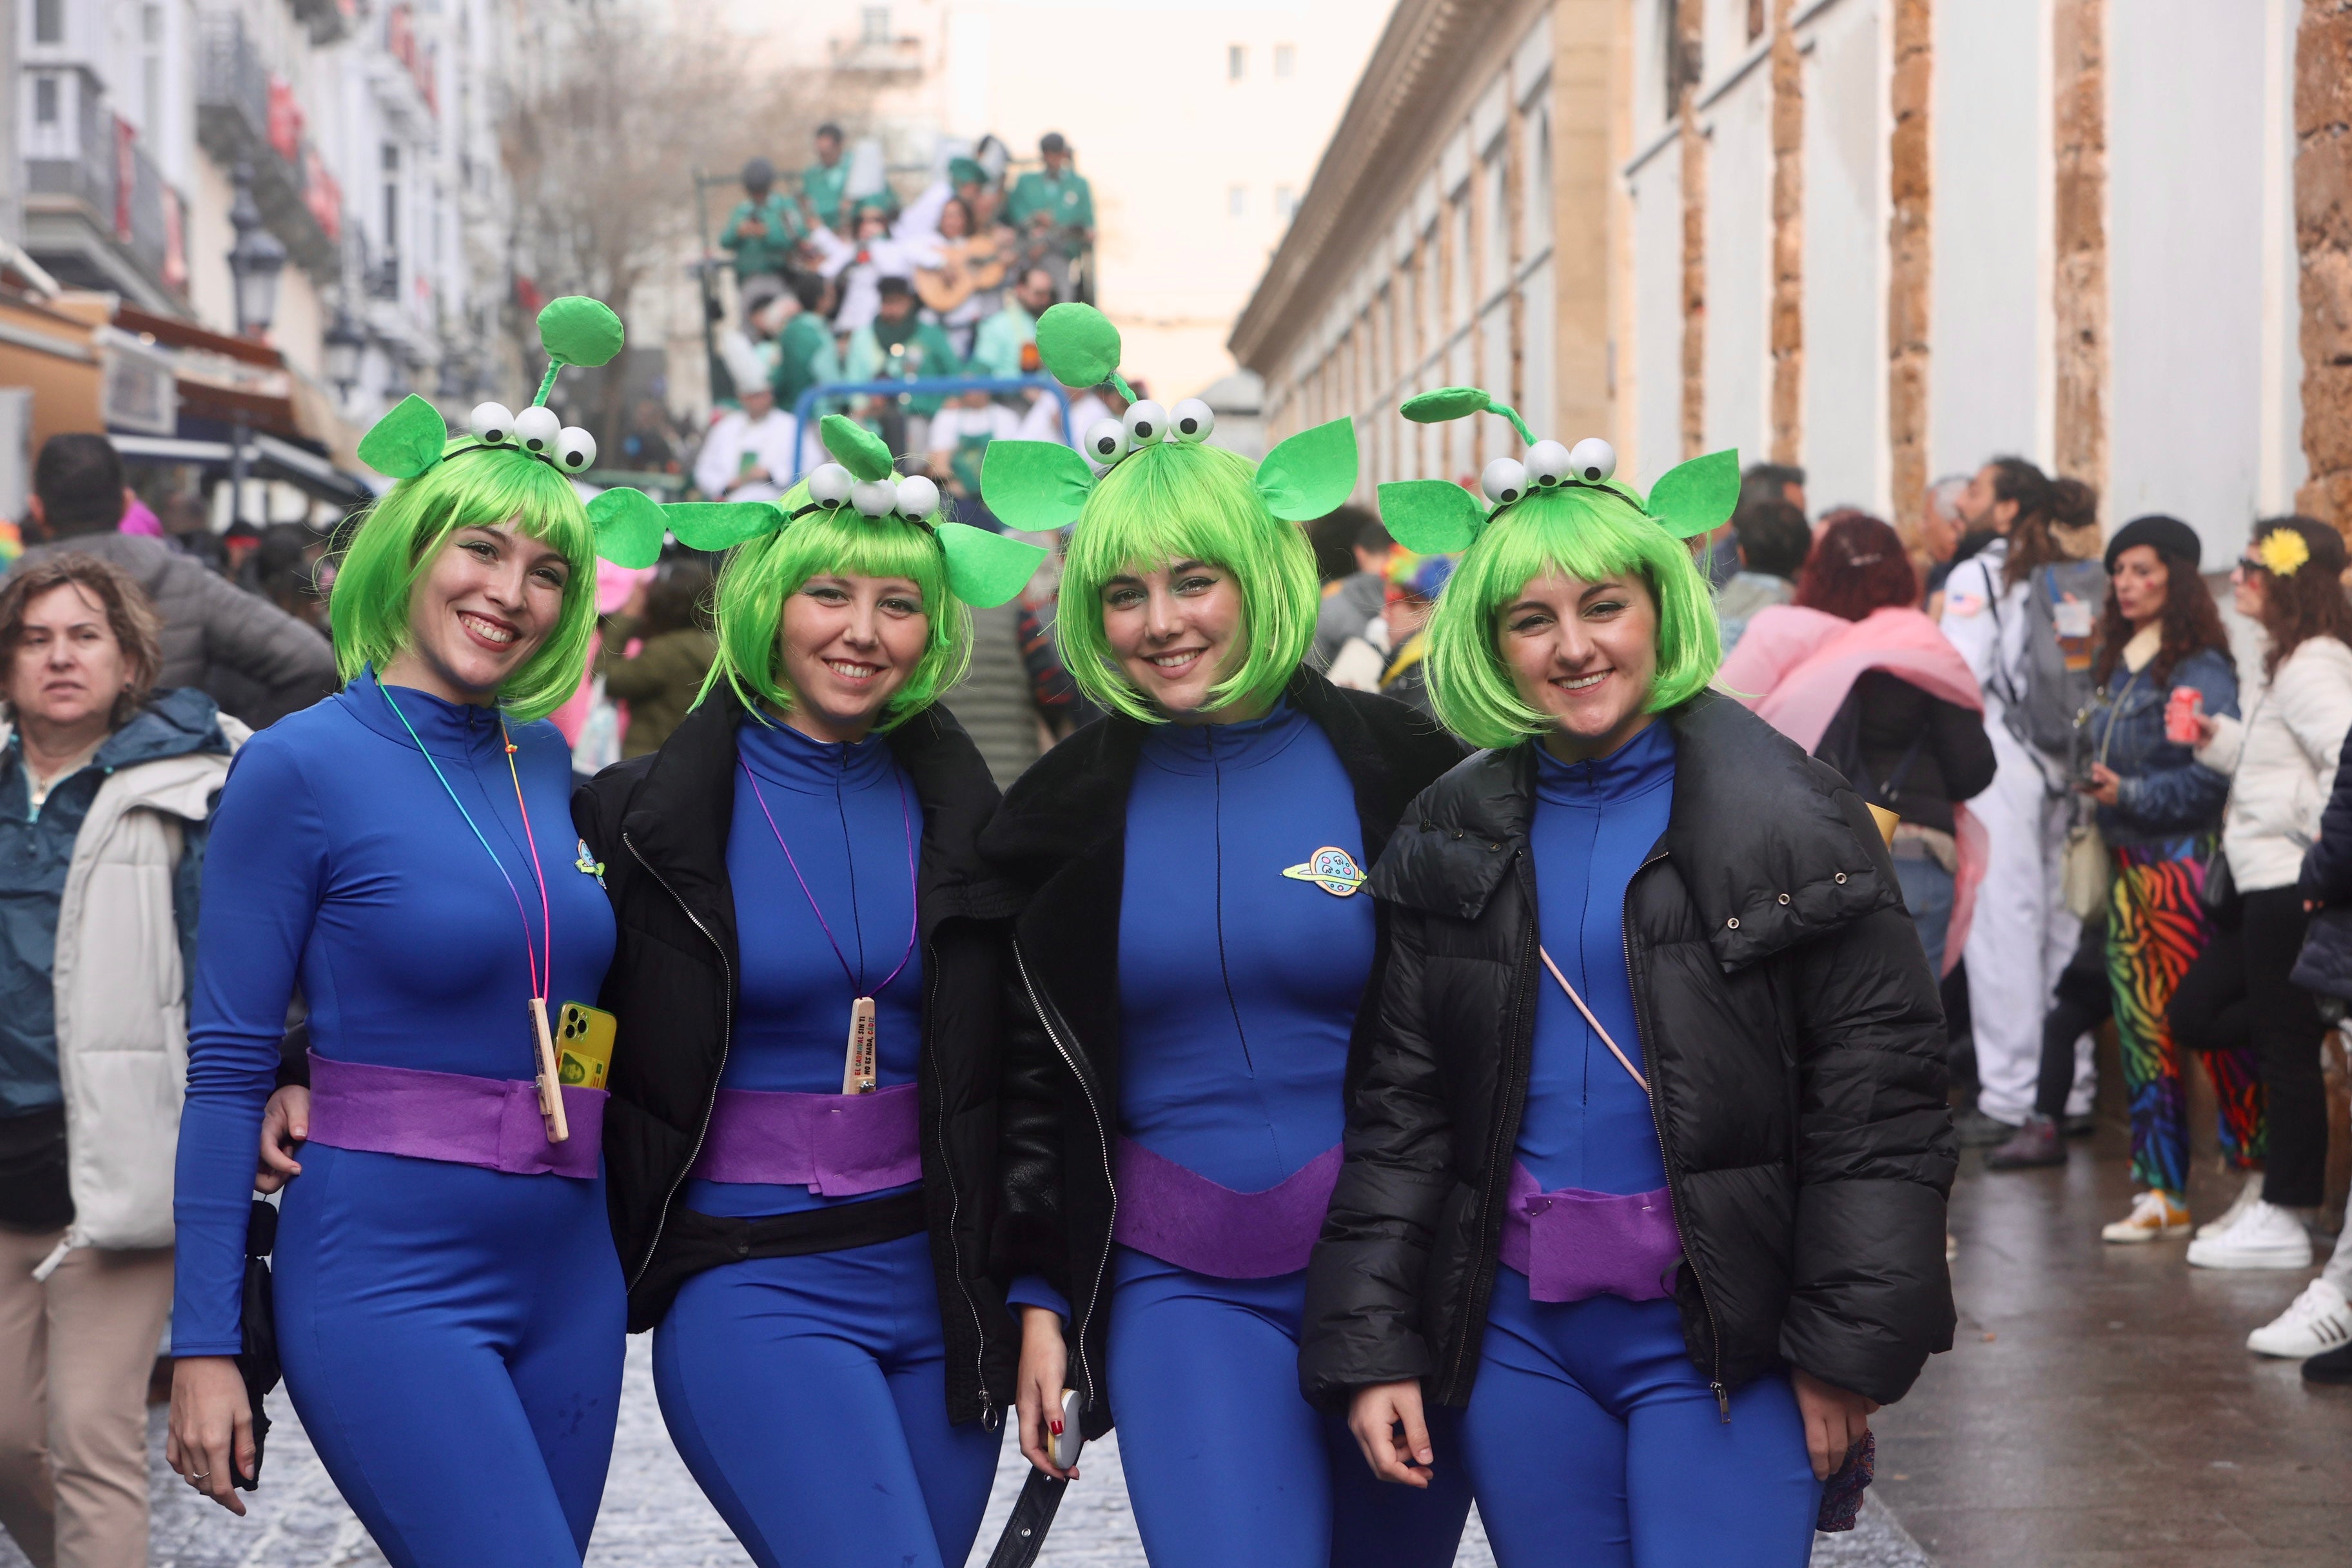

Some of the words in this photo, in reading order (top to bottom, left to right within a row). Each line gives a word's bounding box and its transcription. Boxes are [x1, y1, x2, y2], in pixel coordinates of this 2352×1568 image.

[856, 1036, 864, 1066] CARNAVAL
[866, 1037, 874, 1055] NADA,
[865, 1066, 870, 1075] NO
